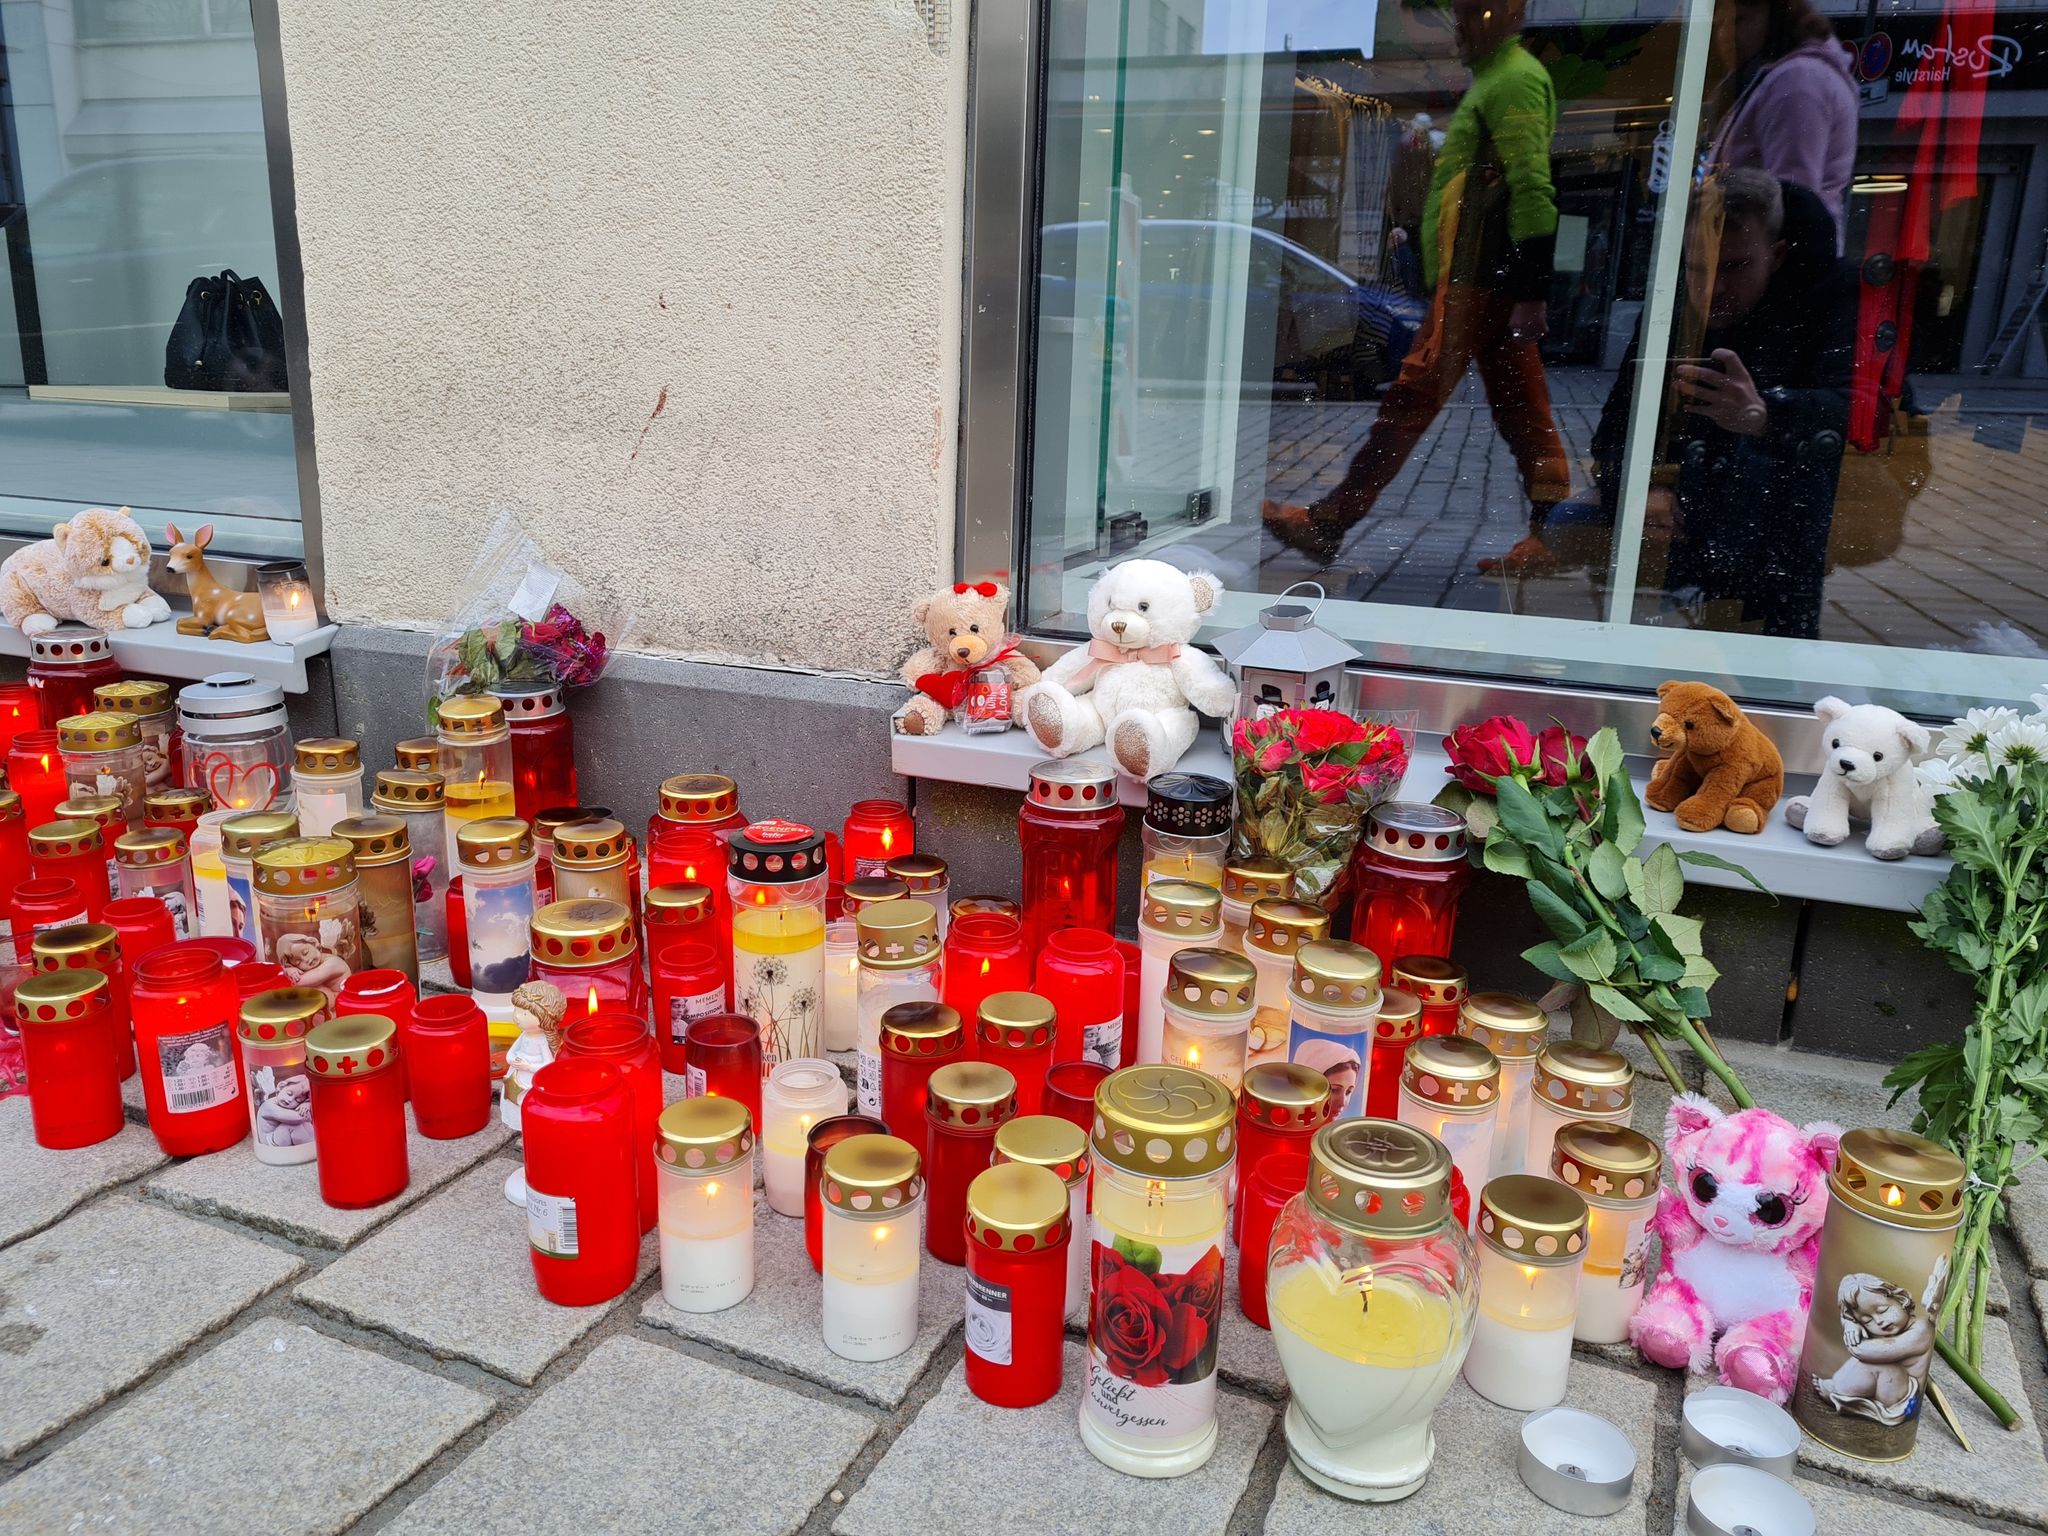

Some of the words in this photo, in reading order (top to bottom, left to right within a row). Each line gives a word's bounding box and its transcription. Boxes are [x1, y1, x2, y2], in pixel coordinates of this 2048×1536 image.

[995, 687, 1008, 714] Love
[1090, 1365, 1137, 1402] Geliebt
[1100, 1389, 1119, 1405] und
[1091, 1391, 1168, 1427] unvergessen
